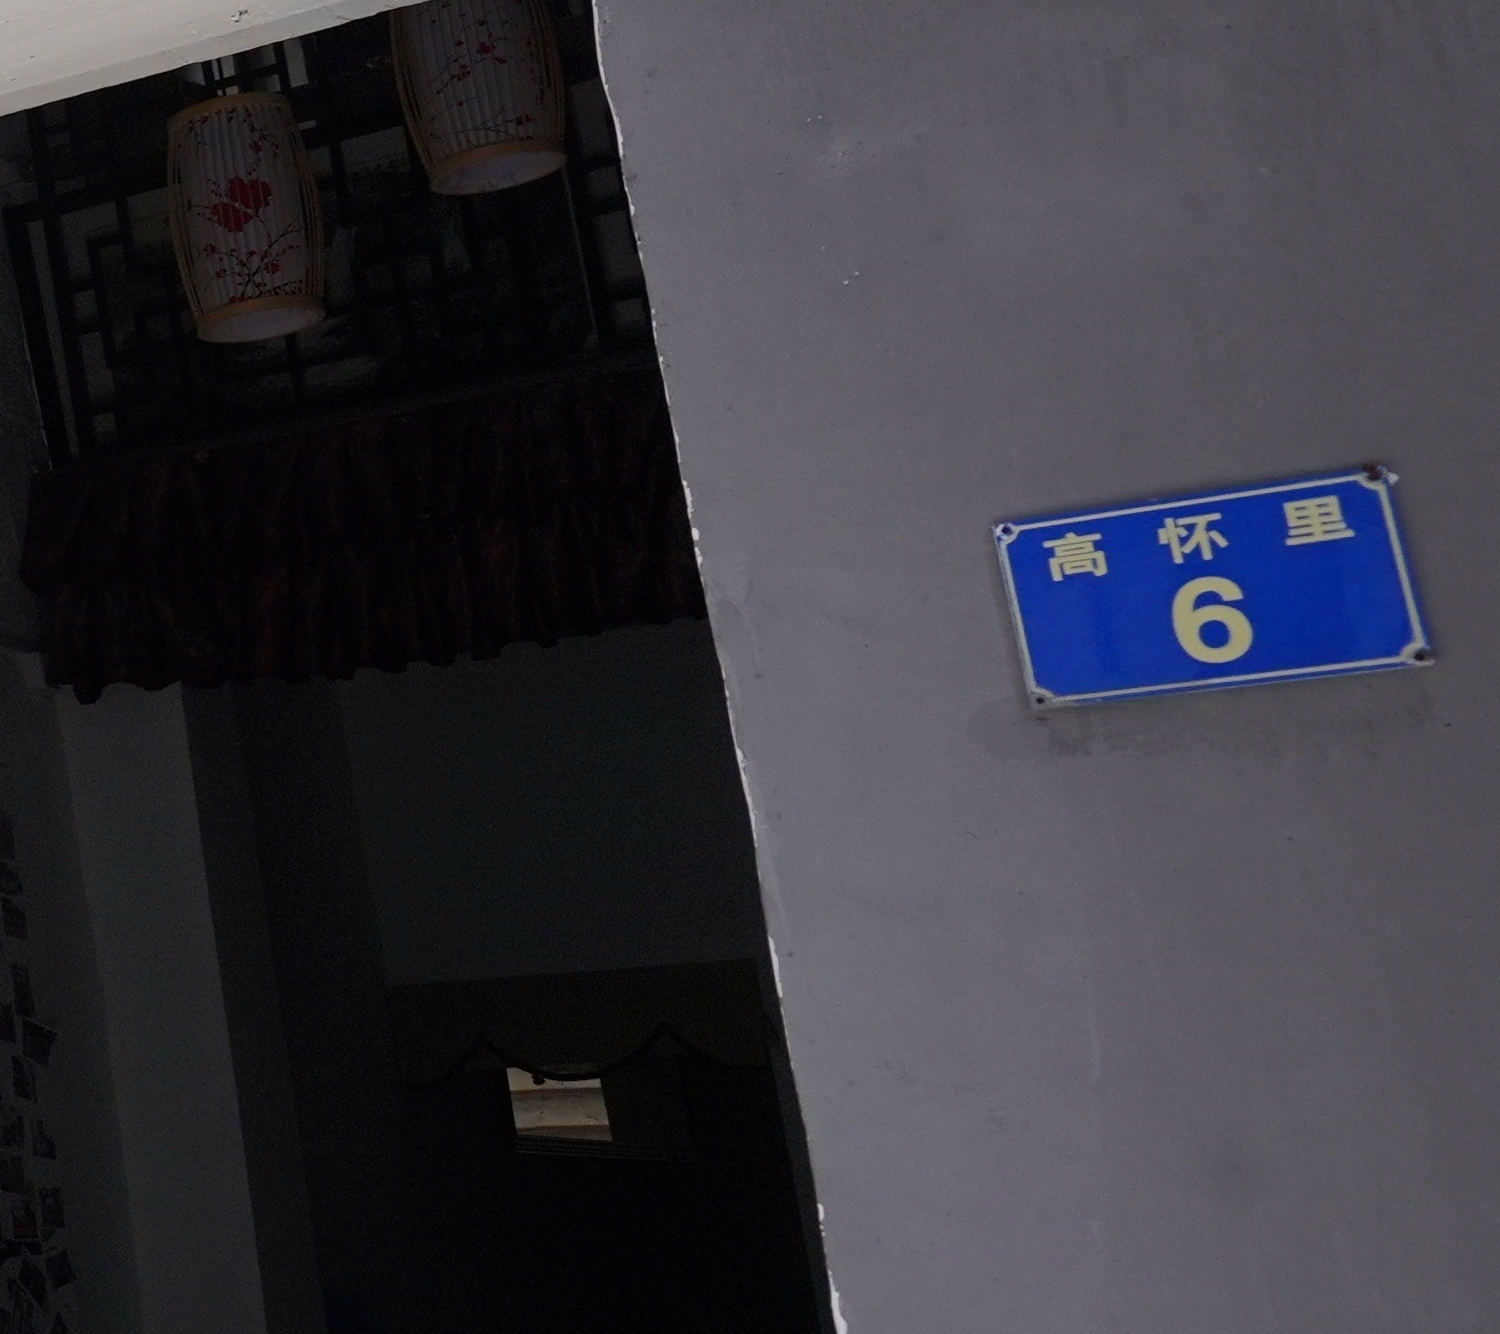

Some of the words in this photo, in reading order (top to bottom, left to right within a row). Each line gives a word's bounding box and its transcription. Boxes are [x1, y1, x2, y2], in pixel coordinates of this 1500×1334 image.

[1042, 495, 1356, 582] 高怀里
[1171, 576, 1254, 665] 6
